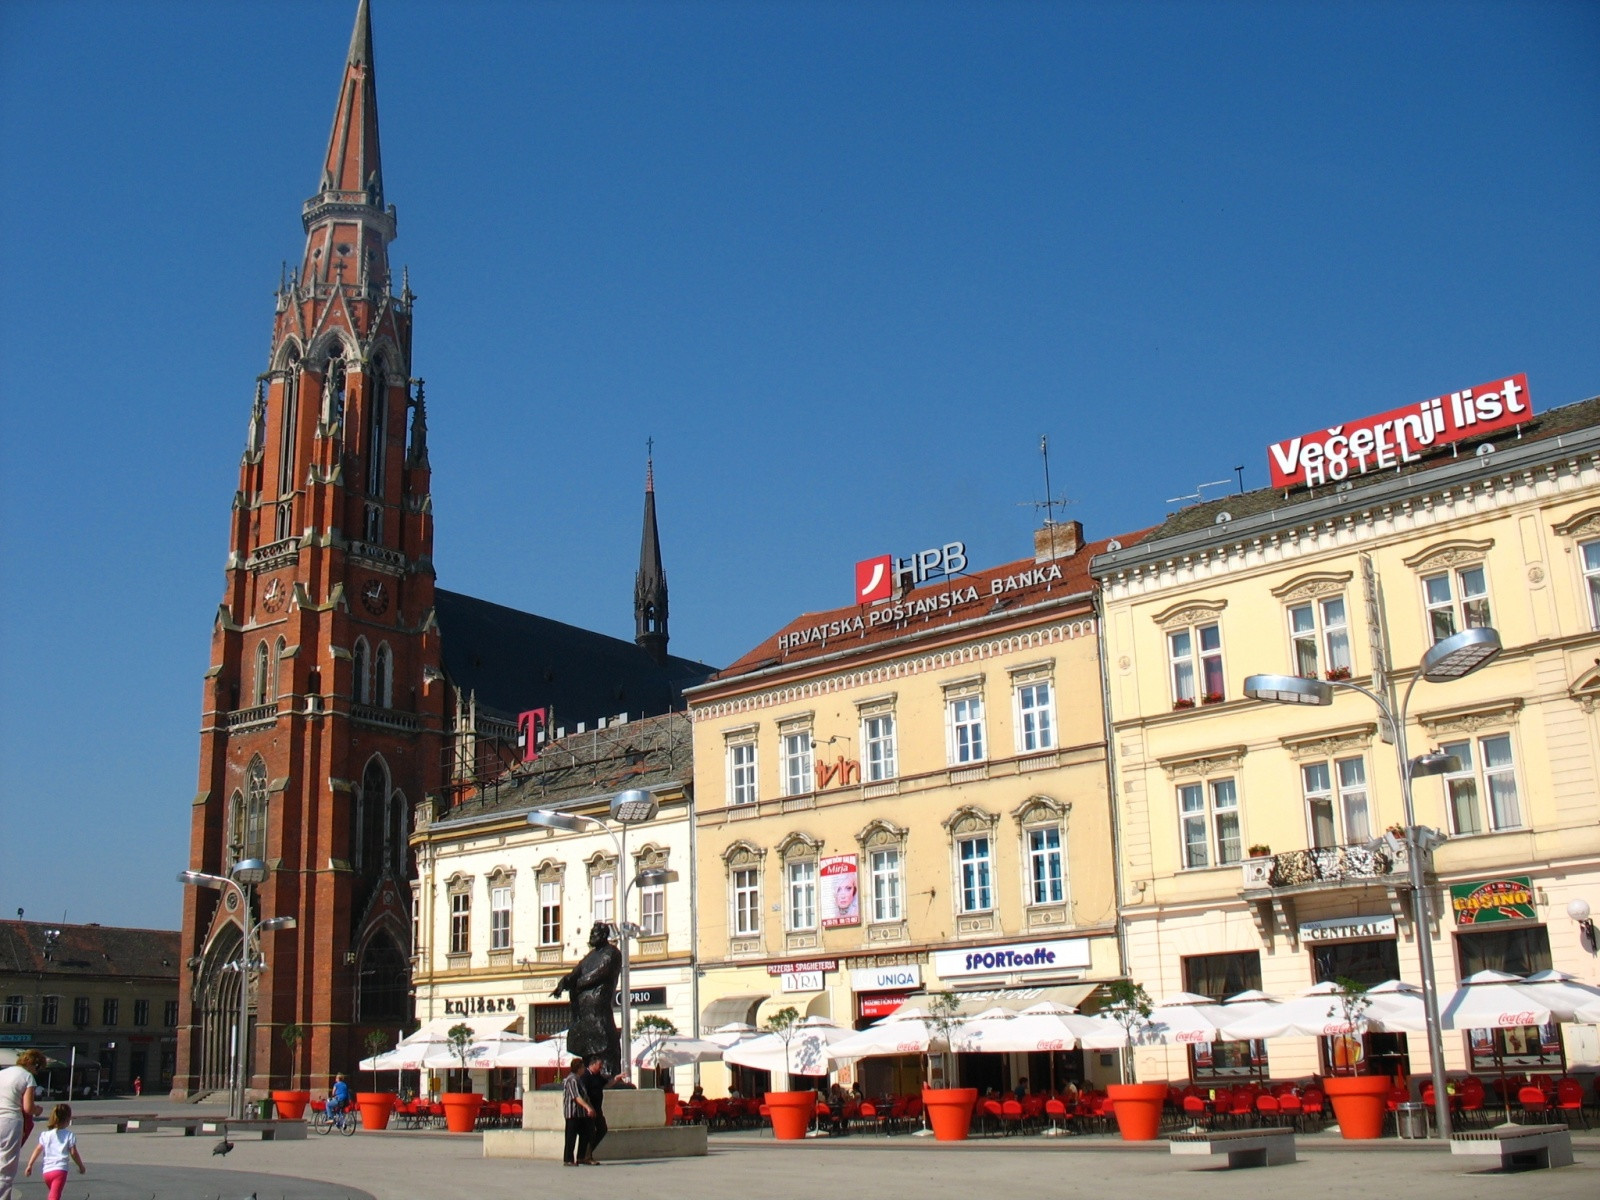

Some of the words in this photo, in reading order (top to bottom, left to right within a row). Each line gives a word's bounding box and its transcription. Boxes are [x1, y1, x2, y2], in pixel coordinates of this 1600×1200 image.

[1270, 398, 1445, 475] Večernji
[1451, 379, 1525, 428] list
[1304, 440, 1421, 488] HOTEL
[896, 541, 967, 588] HPB
[778, 615, 865, 650] HRVATSKA
[869, 585, 979, 627] POŠTANSKA
[991, 563, 1063, 596] BANKA
[518, 707, 546, 762] T
[1453, 891, 1528, 910] CASINO
[1311, 923, 1381, 939] CENTRAL
[767, 964, 794, 974] PIZZERIA
[795, 960, 836, 972] SPAGHETERIA
[965, 948, 1056, 970] SPORTcaffe
[787, 973, 818, 990] LYRA
[877, 973, 915, 986] UNIQA
[445, 996, 516, 1018] knjižara
[616, 991, 650, 1006] CPRIO
